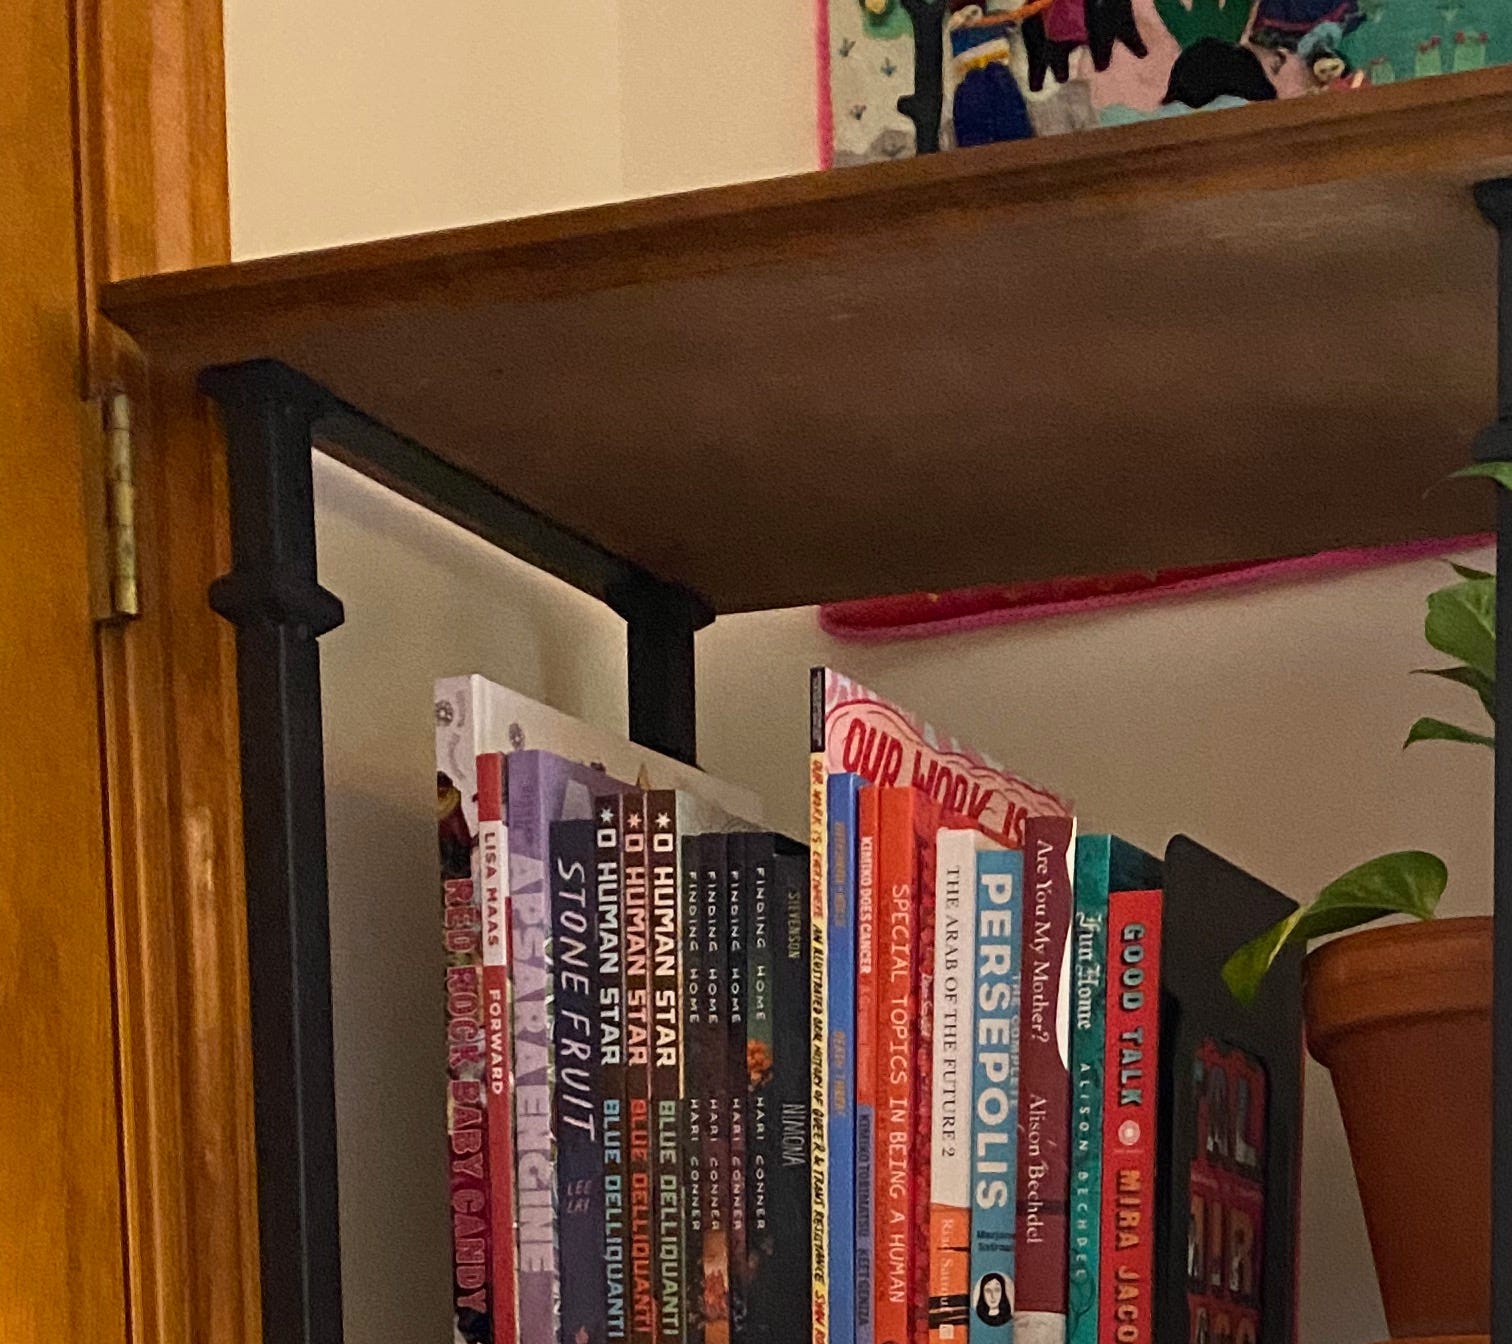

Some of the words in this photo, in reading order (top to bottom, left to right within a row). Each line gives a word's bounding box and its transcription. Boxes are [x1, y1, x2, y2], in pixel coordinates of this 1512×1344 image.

[843, 718, 903, 788] OUR
[484, 832, 498, 880] LISA
[861, 836, 873, 886] KIMIKO
[945, 865, 961, 910] THE
[1036, 839, 1054, 875] Are
[443, 878, 479, 953] RED
[484, 887, 500, 947] MAAS
[557, 857, 590, 996] STONE
[598, 862, 620, 974] HUMAN
[625, 866, 647, 977] HUMAN
[653, 866, 676, 977] HUMAN
[689, 871, 699, 951] FINDING
[707, 870, 718, 952] FINDING
[730, 870, 741, 952] FINDING
[756, 867, 767, 948] FINDING
[788, 891, 801, 959] STEVENSON
[861, 888, 873, 921] DOES
[890, 883, 910, 983] SPECIAL
[1035, 881, 1053, 918] You
[1076, 912, 1103, 960] Fun
[509, 854, 550, 1085] APSARA
[860, 922, 873, 974] CANCER
[944, 916, 960, 971] ARAB
[1030, 924, 1051, 957] My
[1122, 922, 1146, 1010] GOOD
[446, 966, 485, 1069] ROCK
[600, 987, 621, 1066] STAR
[627, 988, 648, 1067] STAR
[655, 989, 677, 1068] STAR
[689, 968, 699, 1024] HOME
[708, 968, 718, 1024] HOME
[731, 967, 741, 1024] HOME
[756, 965, 766, 1020] HOME
[943, 973, 959, 1008] OF
[1030, 961, 1050, 1043] Mother?
[1076, 962, 1101, 1031] Home
[488, 988, 503, 1095] FORWARD
[889, 995, 908, 1085] TOPICS
[943, 1011, 958, 1055] THE
[975, 873, 1014, 1210] PERSEPOLIS
[1121, 1026, 1144, 1106] TALK
[561, 1007, 596, 1142] FRUIT
[889, 1097, 908, 1123] IN
[941, 1058, 957, 1142] FUTURE
[1078, 1063, 1091, 1151] ALISON
[451, 1080, 484, 1179] BABY
[603, 1099, 621, 1164] BLUE
[630, 1098, 648, 1162] BLUE
[658, 1099, 677, 1164] BLUE
[782, 1103, 806, 1167] NIMONA
[941, 1146, 955, 1157] 2
[1028, 1094, 1047, 1157] Alison
[516, 1086, 554, 1272] ENGINE
[888, 1131, 908, 1199] BEING
[1026, 1163, 1048, 1244] Bechdel
[890, 1208, 906, 1224] A
[1075, 1171, 1089, 1277] BECHDEL
[1117, 1169, 1141, 1250] MIRA
[452, 1188, 487, 1314] CANDY
[605, 1175, 625, 1338] DELLIQUANTI
[660, 1174, 680, 1336] DELLIQUANTI
[888, 1234, 905, 1303] HUMAN
